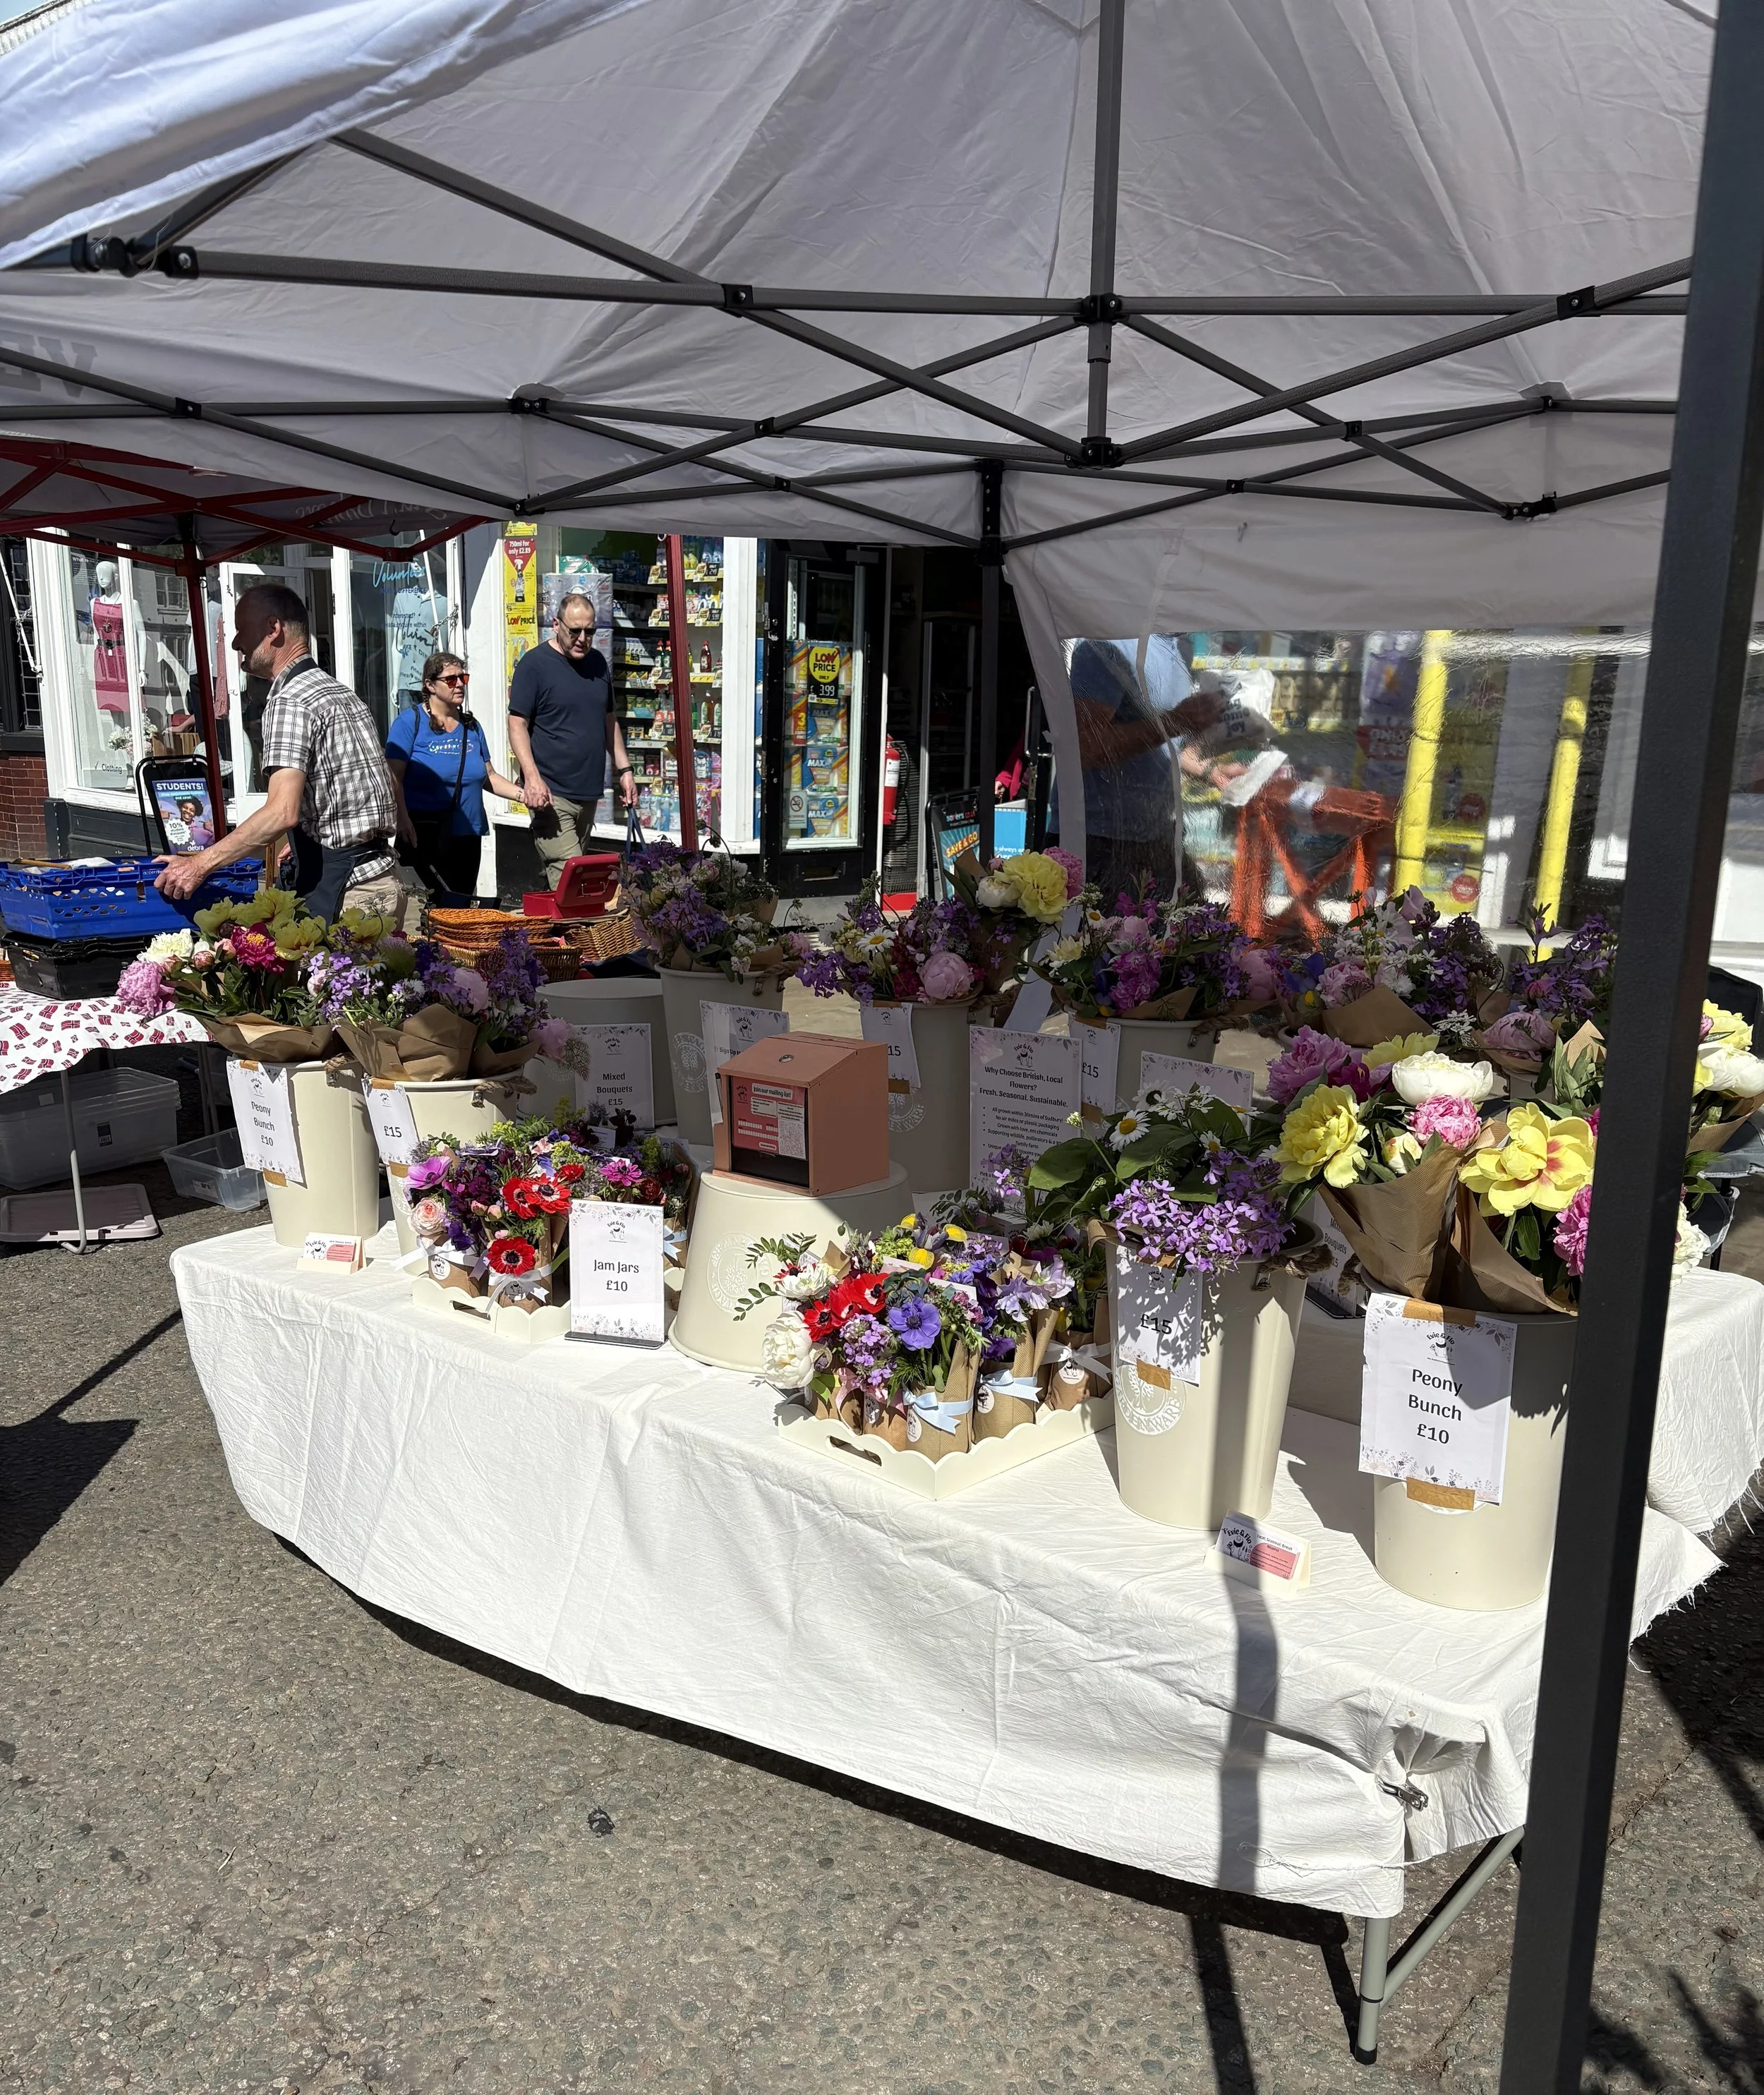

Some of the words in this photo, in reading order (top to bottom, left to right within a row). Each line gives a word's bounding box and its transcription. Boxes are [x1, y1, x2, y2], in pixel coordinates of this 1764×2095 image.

[507, 615, 521, 626] LOW
[520, 617, 536, 626] PRICE
[815, 649, 838, 663] LOW
[813, 663, 836, 672] PRICE
[819, 684, 835, 696] 3.99
[797, 712, 806, 727] 3
[812, 709, 830, 718] MAX
[102, 763, 122, 774] Clothing
[807, 759, 826, 767] MAX
[807, 810, 826, 819] MAX
[946, 839, 964, 859] SAVE
[962, 836, 968, 847] &
[967, 831, 979, 844] GO
[998, 845, 1017, 854] always
[888, 1045, 901, 1056] 15
[602, 1072, 626, 1081] Mixed
[984, 1066, 998, 1075] Why
[999, 1068, 1022, 1077] Choose
[1022, 1072, 1046, 1082] British,
[1046, 1075, 1063, 1084] Local
[1082, 1062, 1099, 1078] £15
[596, 1085, 633, 1094] Bouquets
[1010, 1081, 1037, 1091] Flowers?
[768, 1089, 783, 1097] mailing
[979, 1087, 998, 1097] Fresh.
[998, 1090, 1029, 1101] Seasonal.
[1029, 1095, 1068, 1108] Sustainable.
[250, 1101, 271, 1116] Peony
[253, 1117, 275, 1132] Bunch
[1038, 1122, 1059, 1130] packaging
[384, 1125, 402, 1138] £15
[260, 1134, 274, 1147] £10
[1324, 1233, 1347, 1255] Bouquets
[593, 1259, 615, 1272] Jam
[617, 1261, 639, 1274] Jars
[606, 1280, 628, 1292] £10
[1140, 1314, 1172, 1335] £15
[1426, 1332, 1441, 1341] Evie
[1445, 1335, 1455, 1345] Flo
[1412, 1368, 1463, 1397] Peony
[1408, 1394, 1462, 1422] Bunch
[1416, 1423, 1450, 1444] £10
[1227, 1528, 1239, 1537] Evie
[1239, 1528, 1245, 1537] &
[1244, 1533, 1252, 1545] Flo
